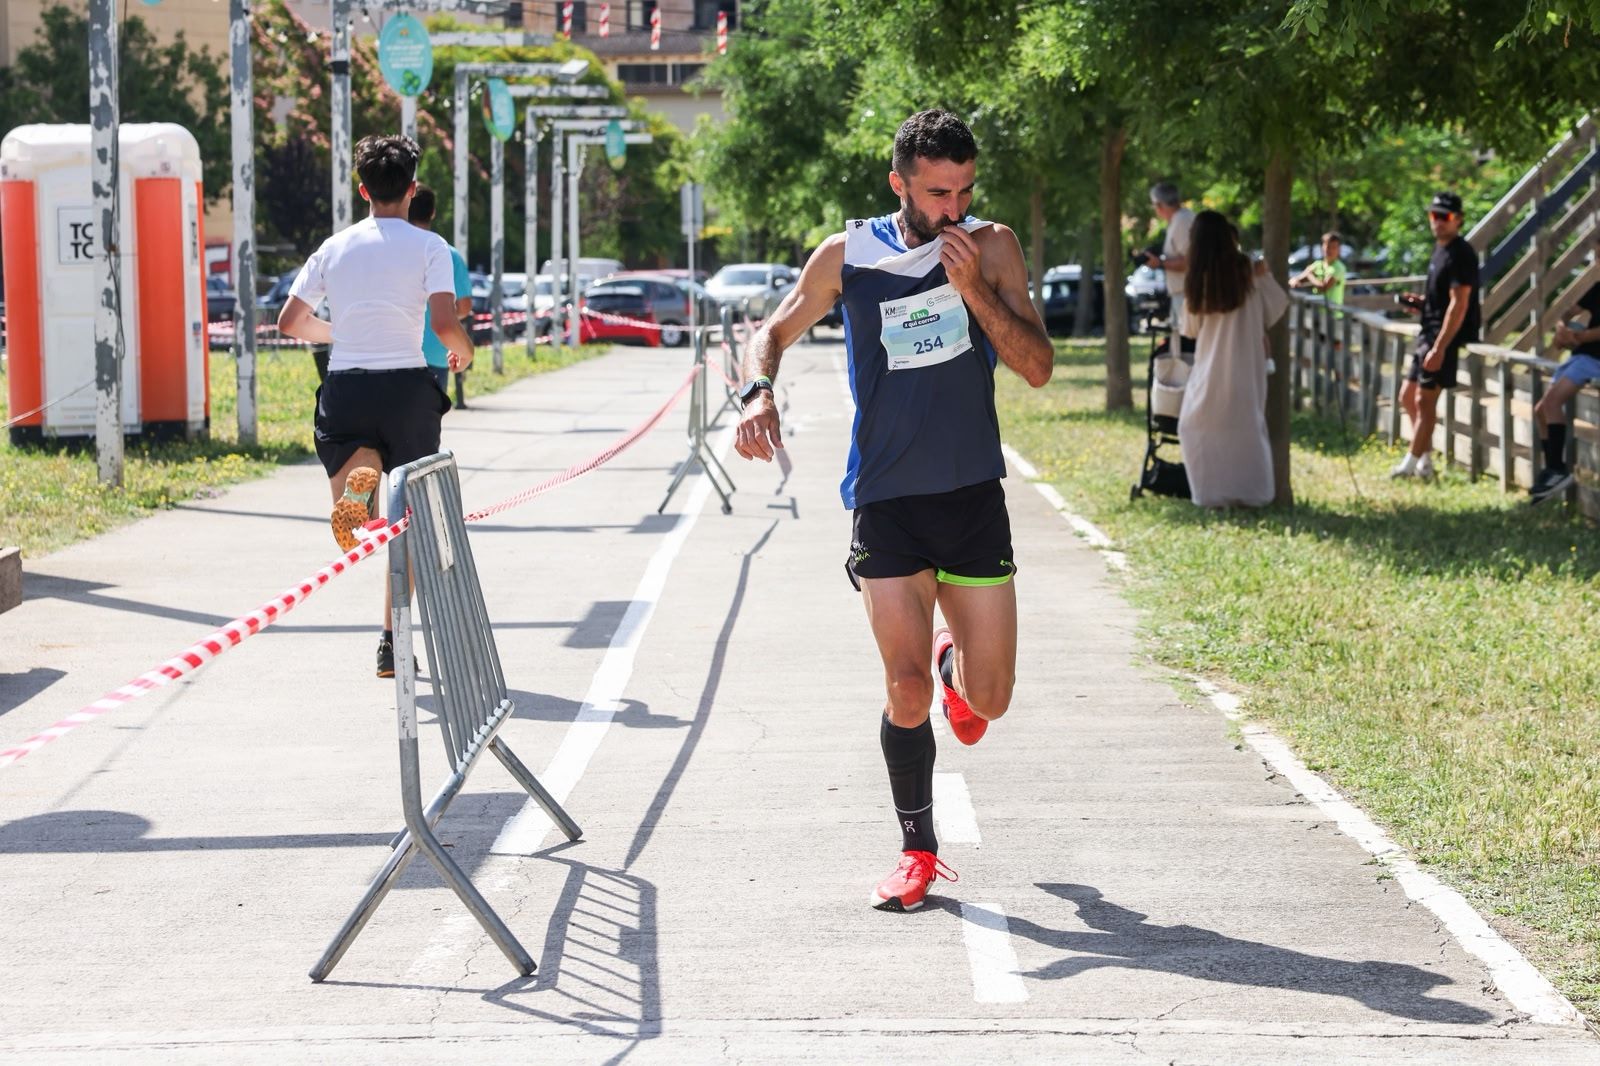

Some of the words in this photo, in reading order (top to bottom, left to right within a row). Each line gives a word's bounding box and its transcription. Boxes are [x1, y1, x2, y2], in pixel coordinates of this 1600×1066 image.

[69, 222, 94, 240] TO
[70, 241, 94, 259] TO
[908, 320, 918, 328] qui
[913, 335, 944, 355] 254
